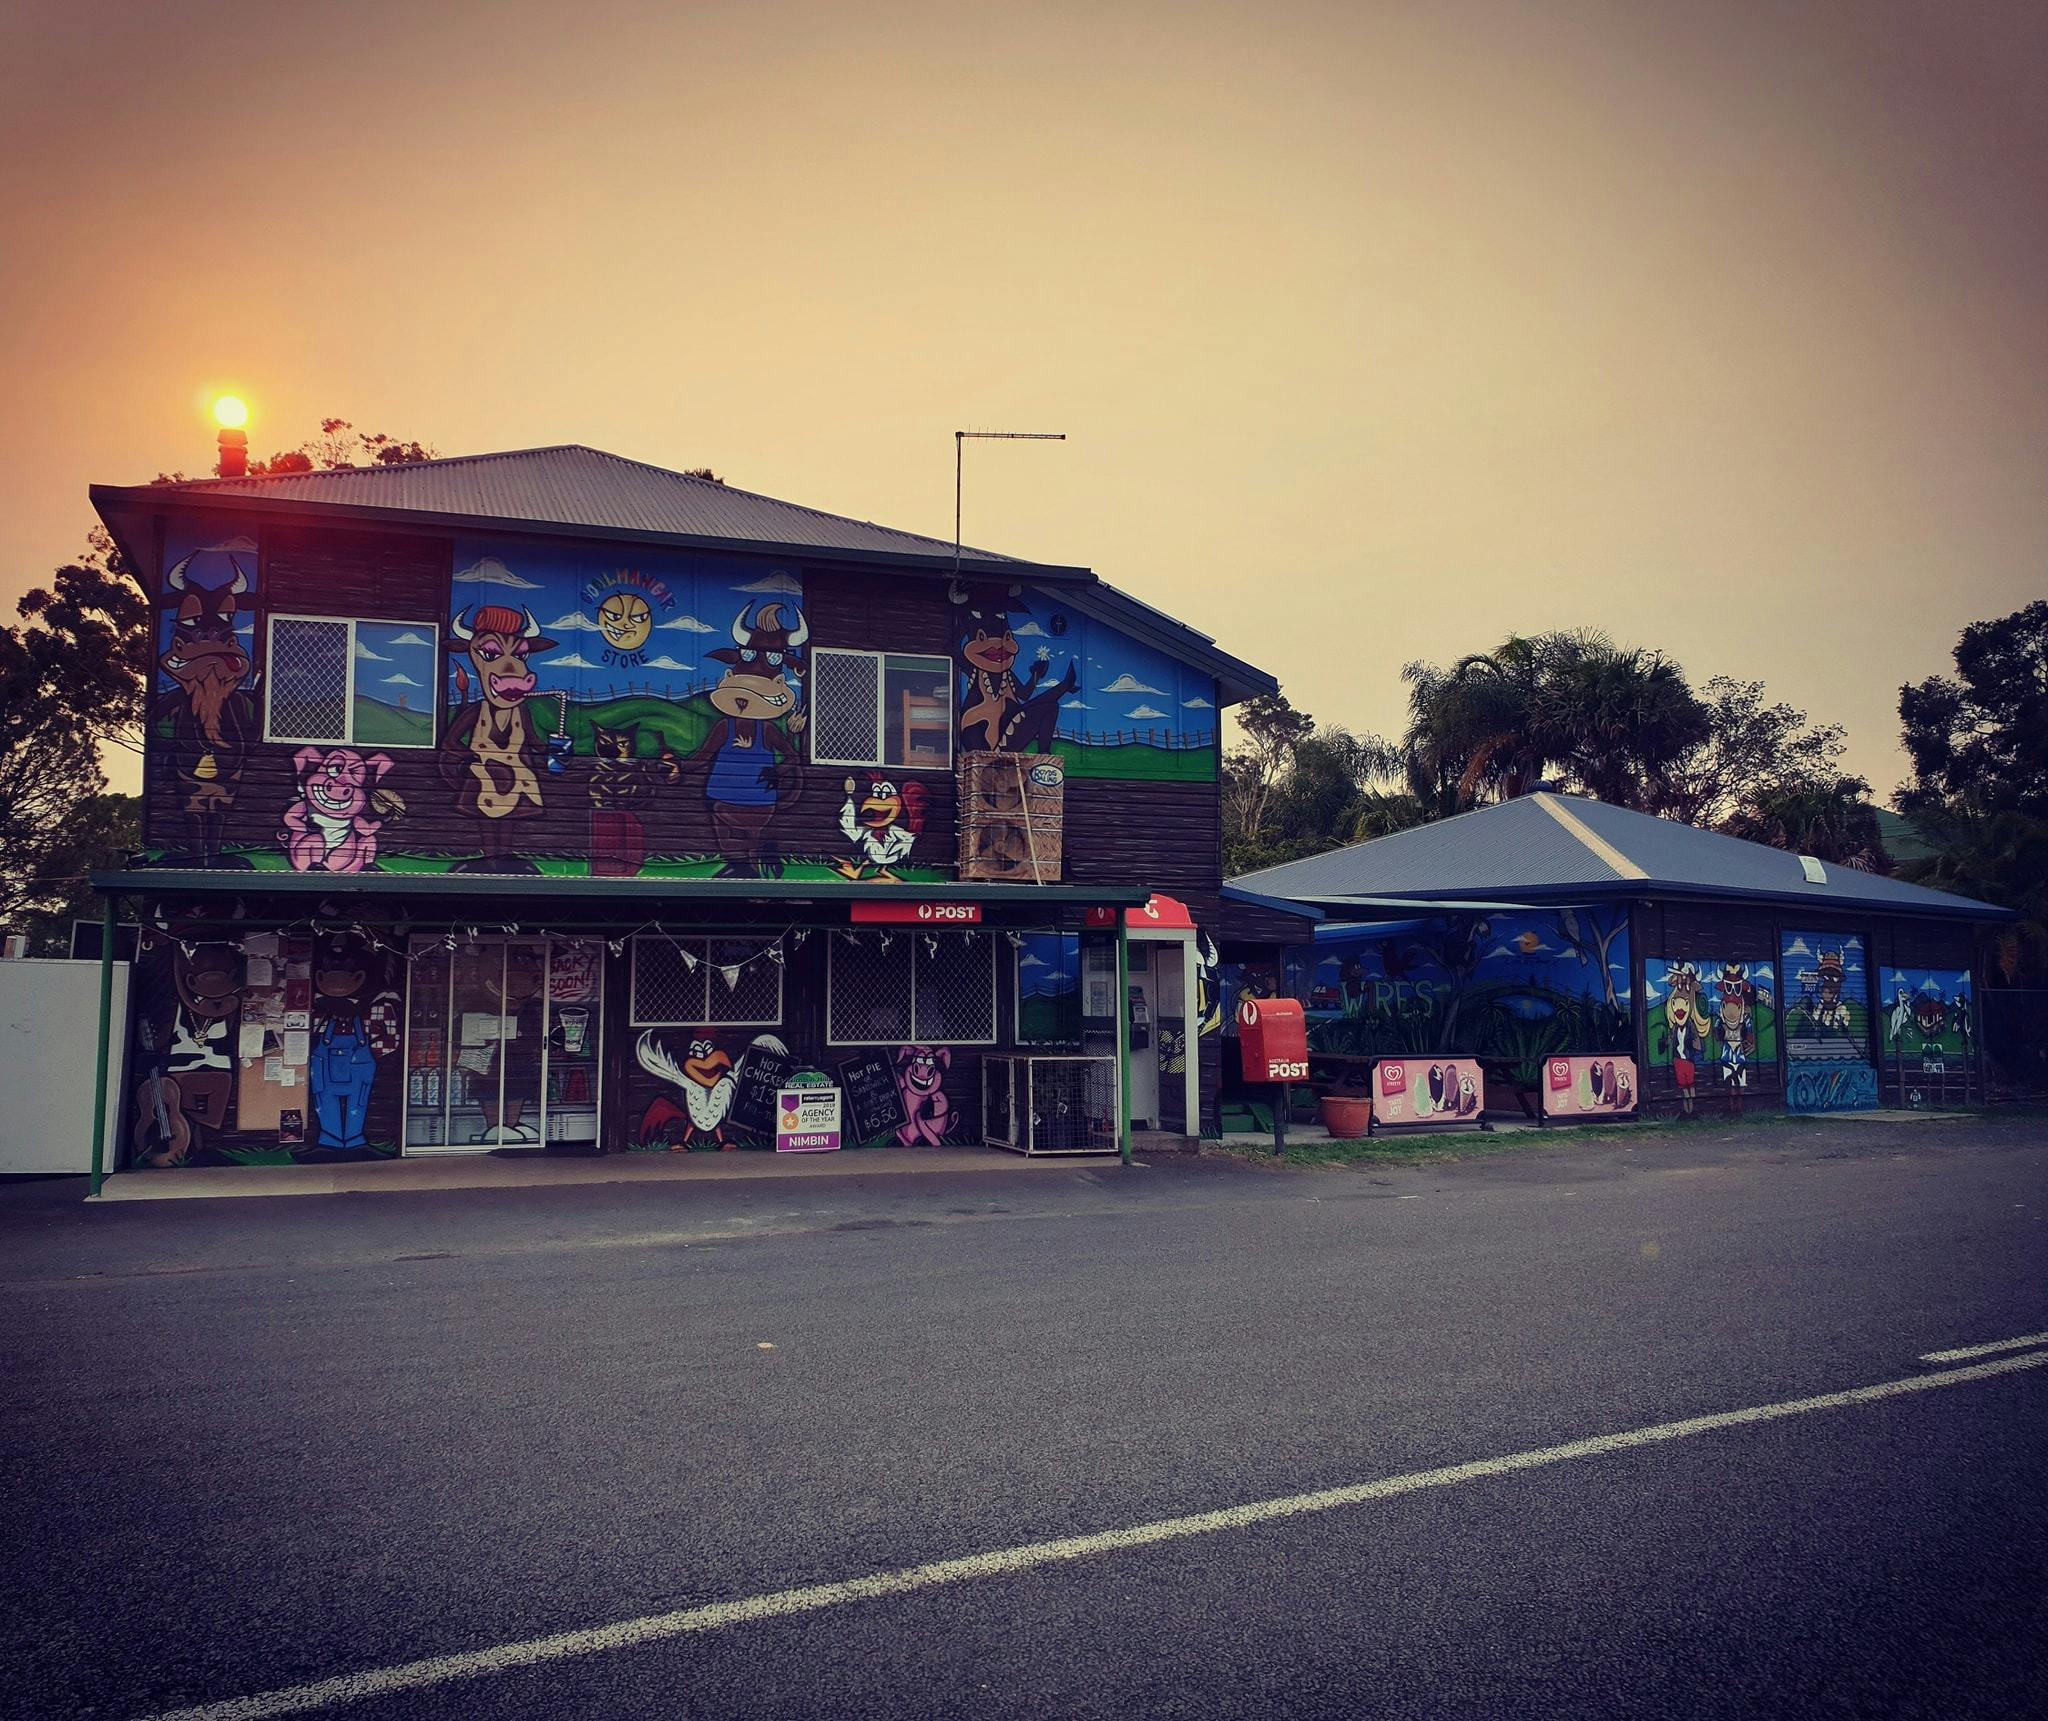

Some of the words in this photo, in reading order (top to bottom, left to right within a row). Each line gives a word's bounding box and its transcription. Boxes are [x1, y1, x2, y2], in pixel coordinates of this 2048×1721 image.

[601, 648, 649, 669] STORE
[935, 906, 976, 919] POST
[759, 1056, 782, 1072] HOT
[865, 1062, 882, 1075] PIE
[1268, 1062, 1309, 1078] POST
[801, 1108, 835, 1117] AGENCY
[1388, 1105, 1402, 1116] JOY
[789, 1135, 829, 1147] NIMBIN
